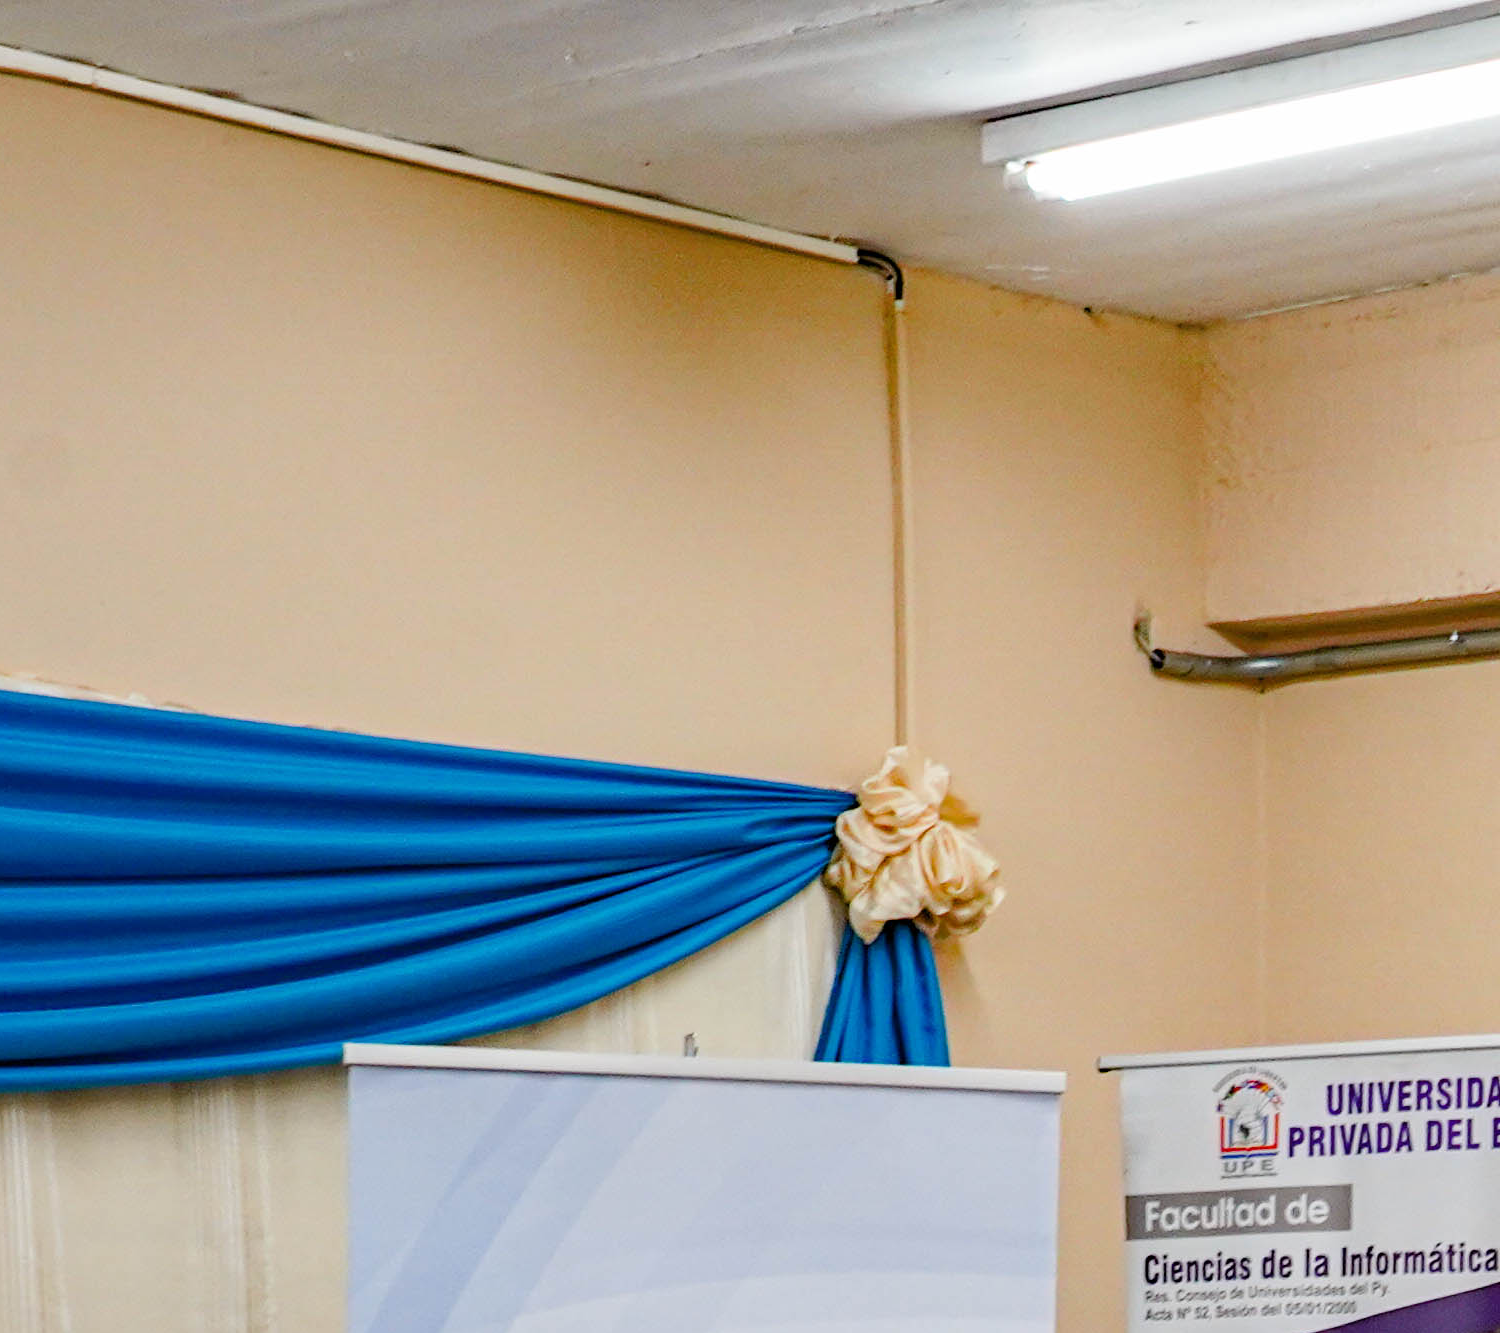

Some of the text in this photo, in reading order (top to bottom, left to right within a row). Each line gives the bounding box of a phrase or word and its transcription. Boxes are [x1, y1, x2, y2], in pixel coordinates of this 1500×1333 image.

[1288, 1121, 1412, 1157] PRIVADA
[1425, 1118, 1480, 1151] DEL
[1144, 1193, 1329, 1232] Facultad de
[1144, 1242, 1498, 1285] Ciencias de la Informática
